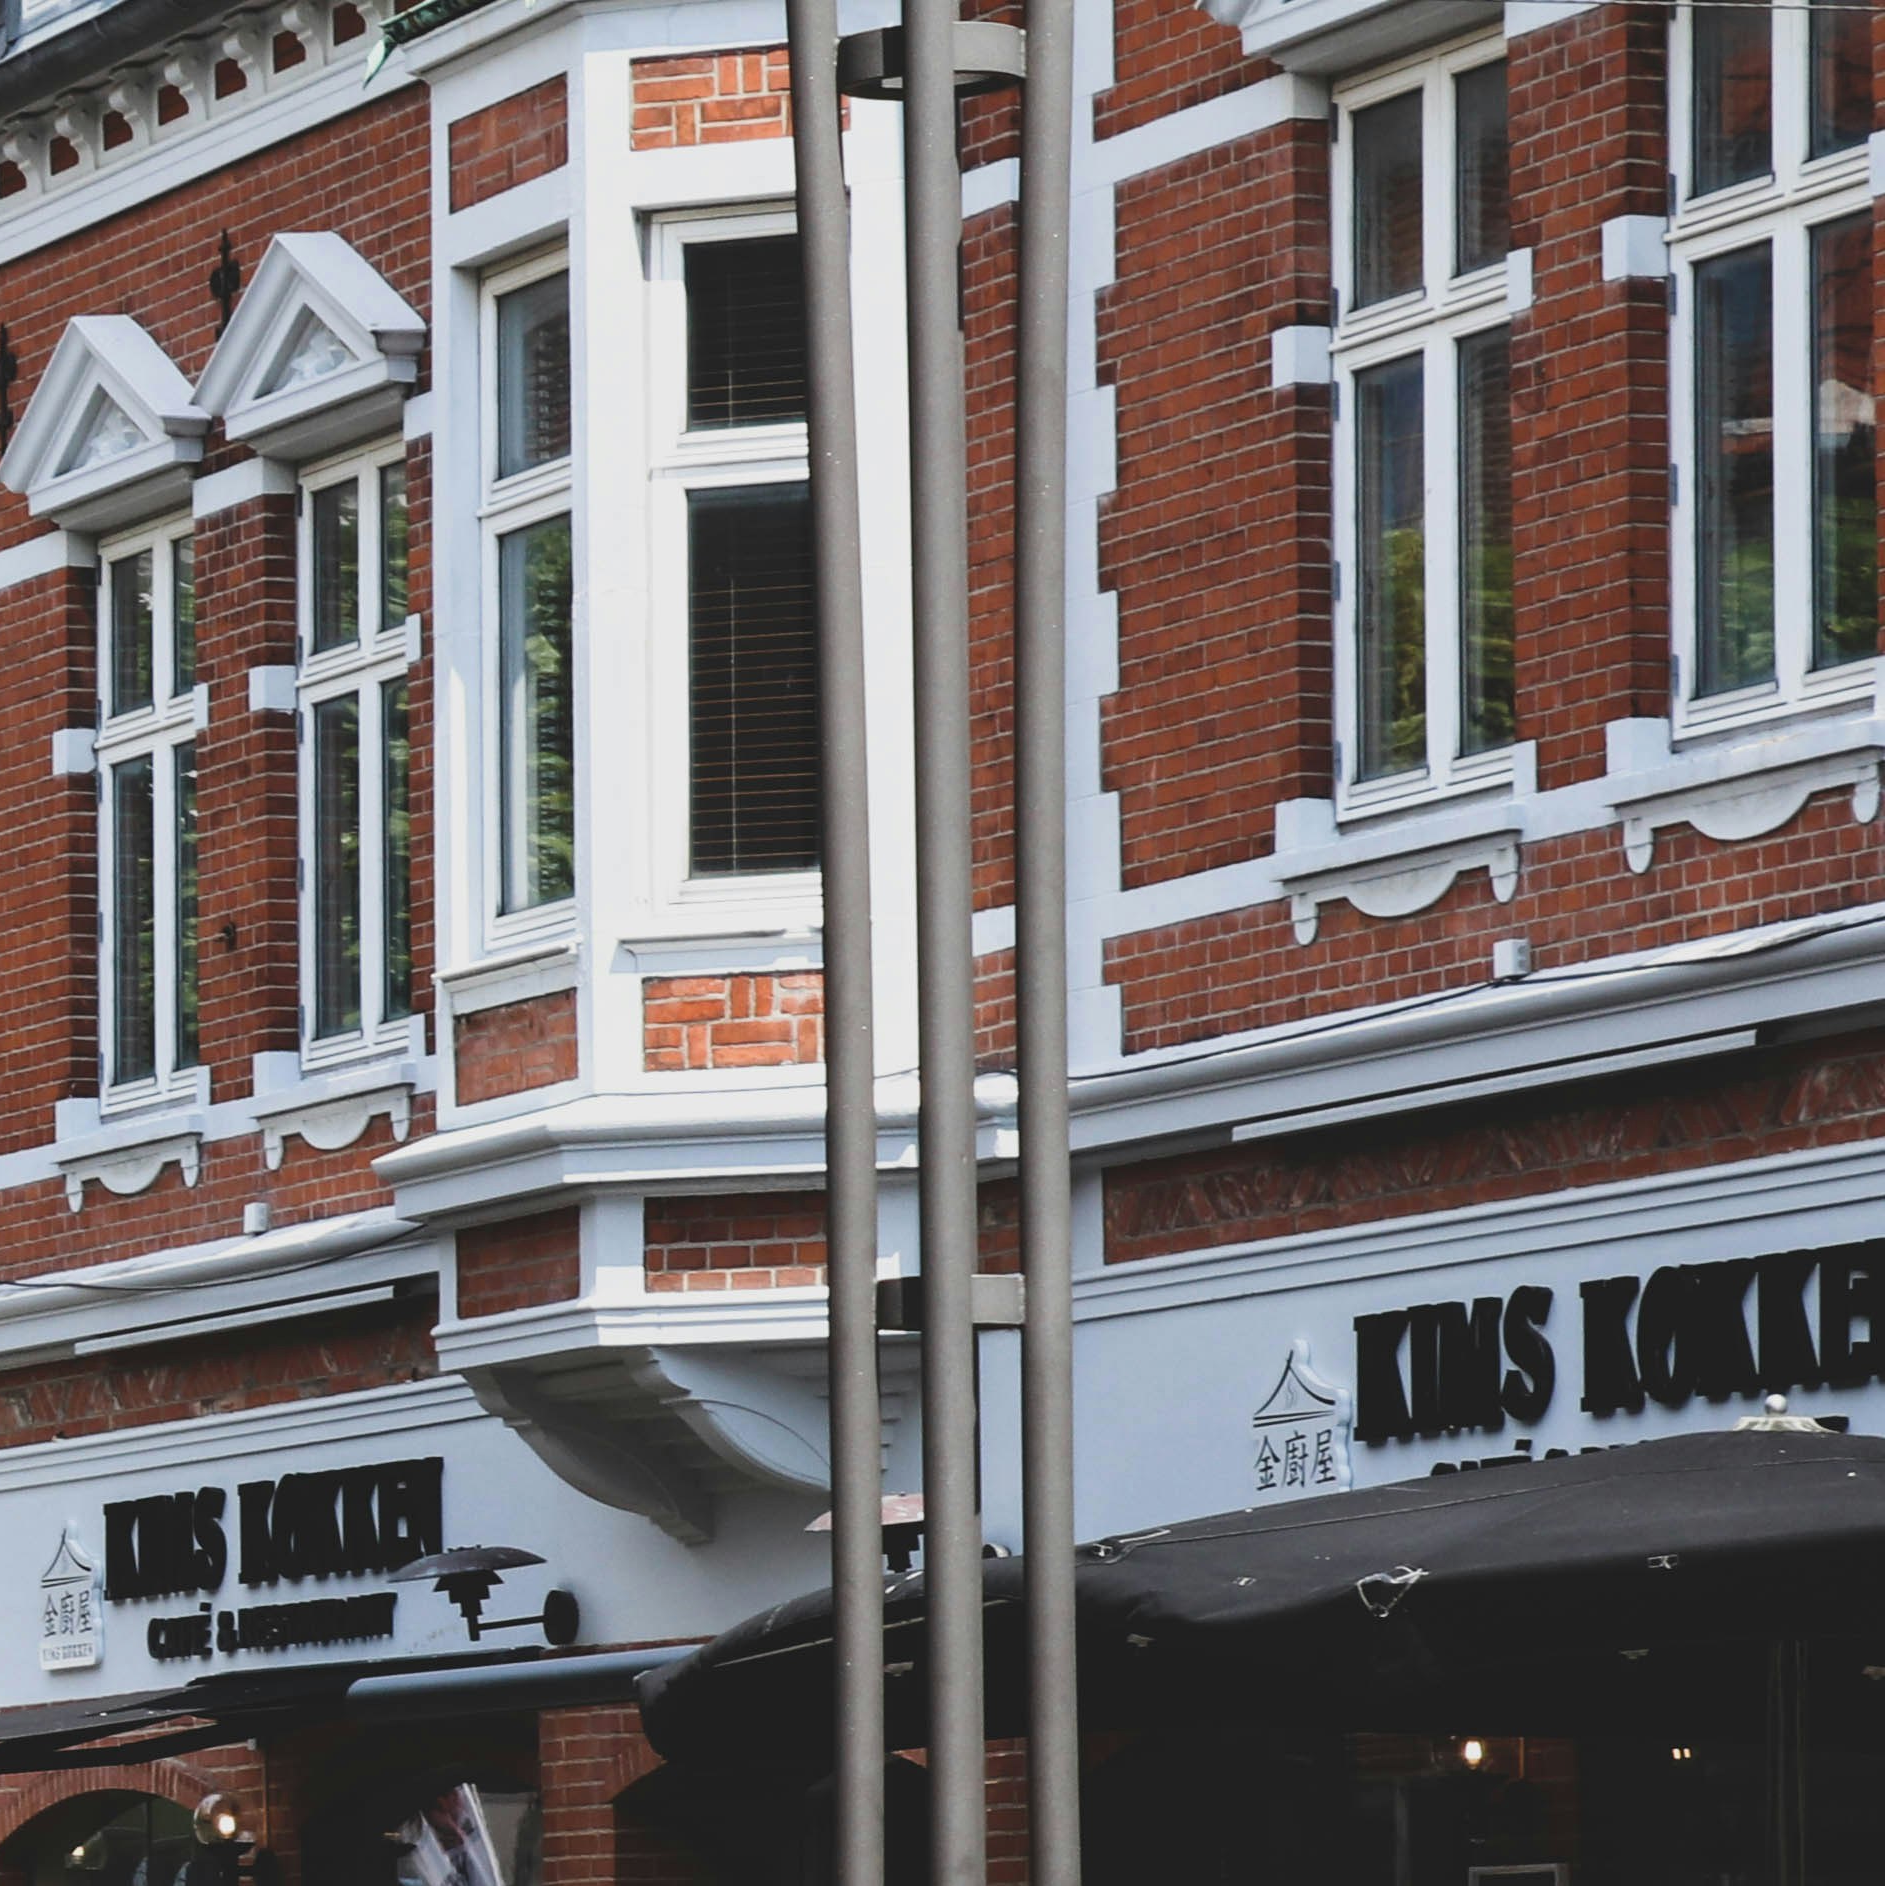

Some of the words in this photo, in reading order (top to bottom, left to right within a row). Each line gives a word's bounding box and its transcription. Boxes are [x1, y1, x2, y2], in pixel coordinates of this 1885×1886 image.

[1353, 1284, 1555, 1444] KIMS
[1579, 1237, 1885, 1414] KØKKE
[104, 1486, 227, 1603] KIMS
